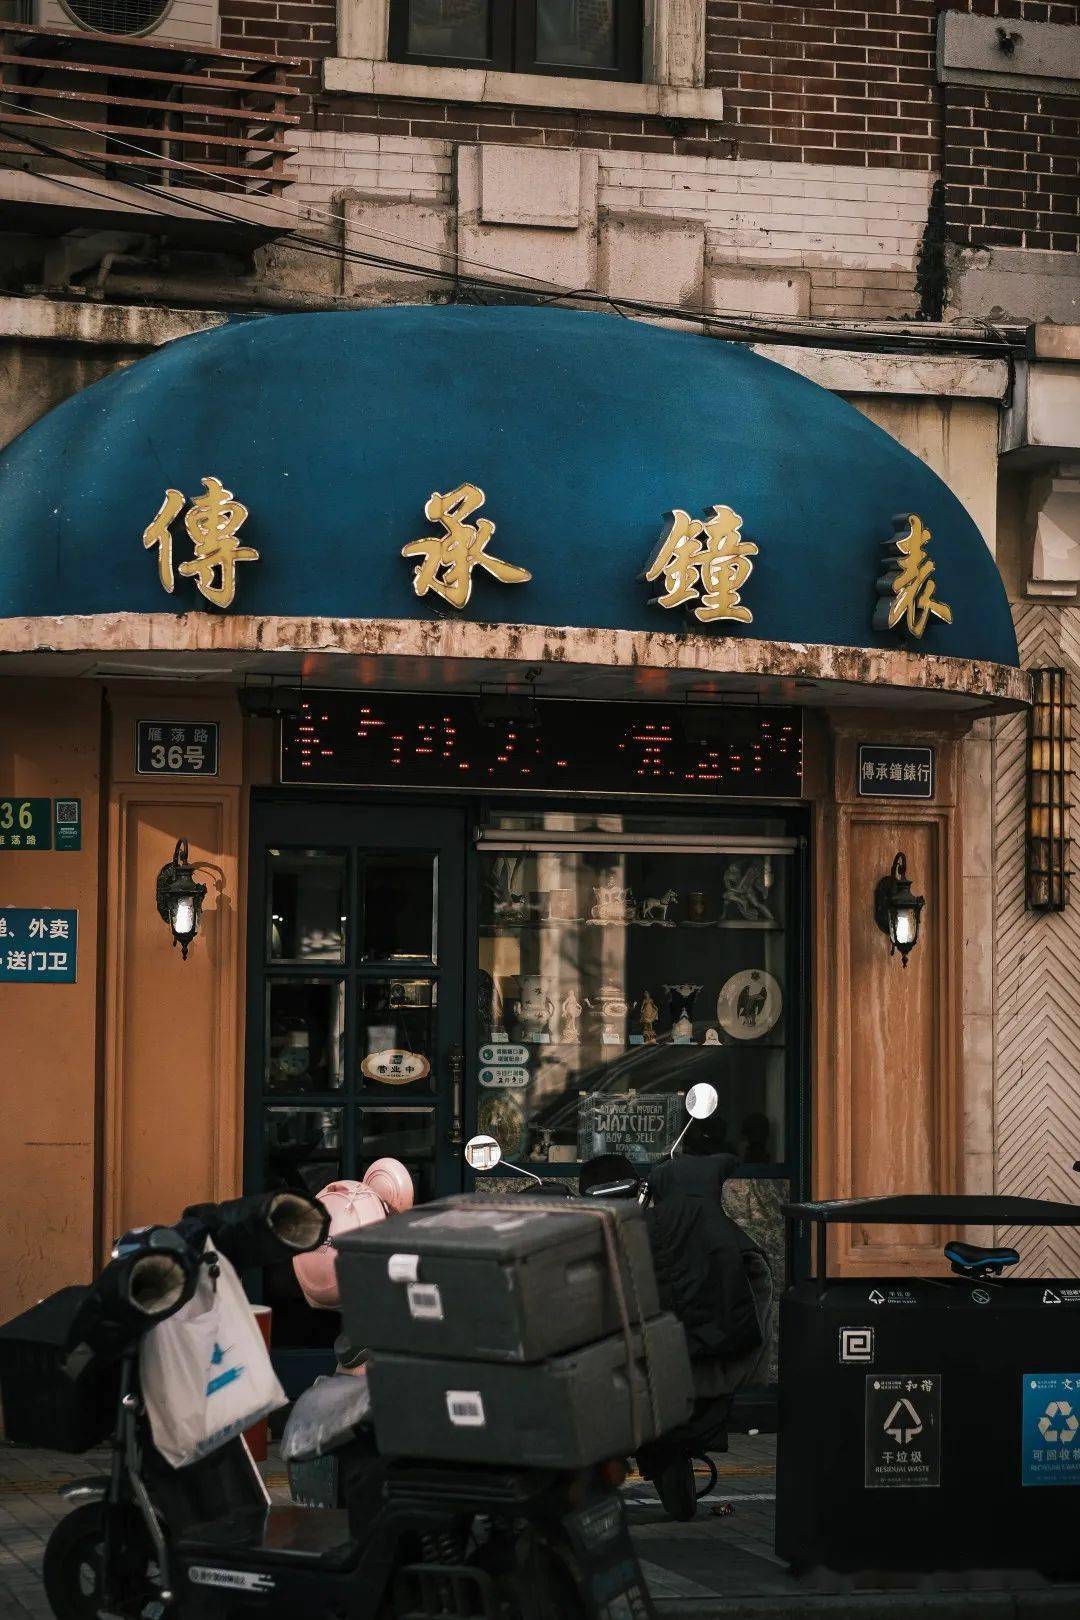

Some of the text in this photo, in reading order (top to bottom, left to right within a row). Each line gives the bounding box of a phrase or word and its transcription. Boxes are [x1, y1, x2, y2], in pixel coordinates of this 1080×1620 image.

[148, 727, 208, 743] 雁荡路
[151, 745, 205, 770] 36号
[1, 802, 33, 829] 36
[597, 1115, 665, 1132] WATCHES
[635, 1132, 655, 1142] SELL
[881, 1451, 923, 1464] 干垃圾
[908, 1464, 930, 1472] WASTE
